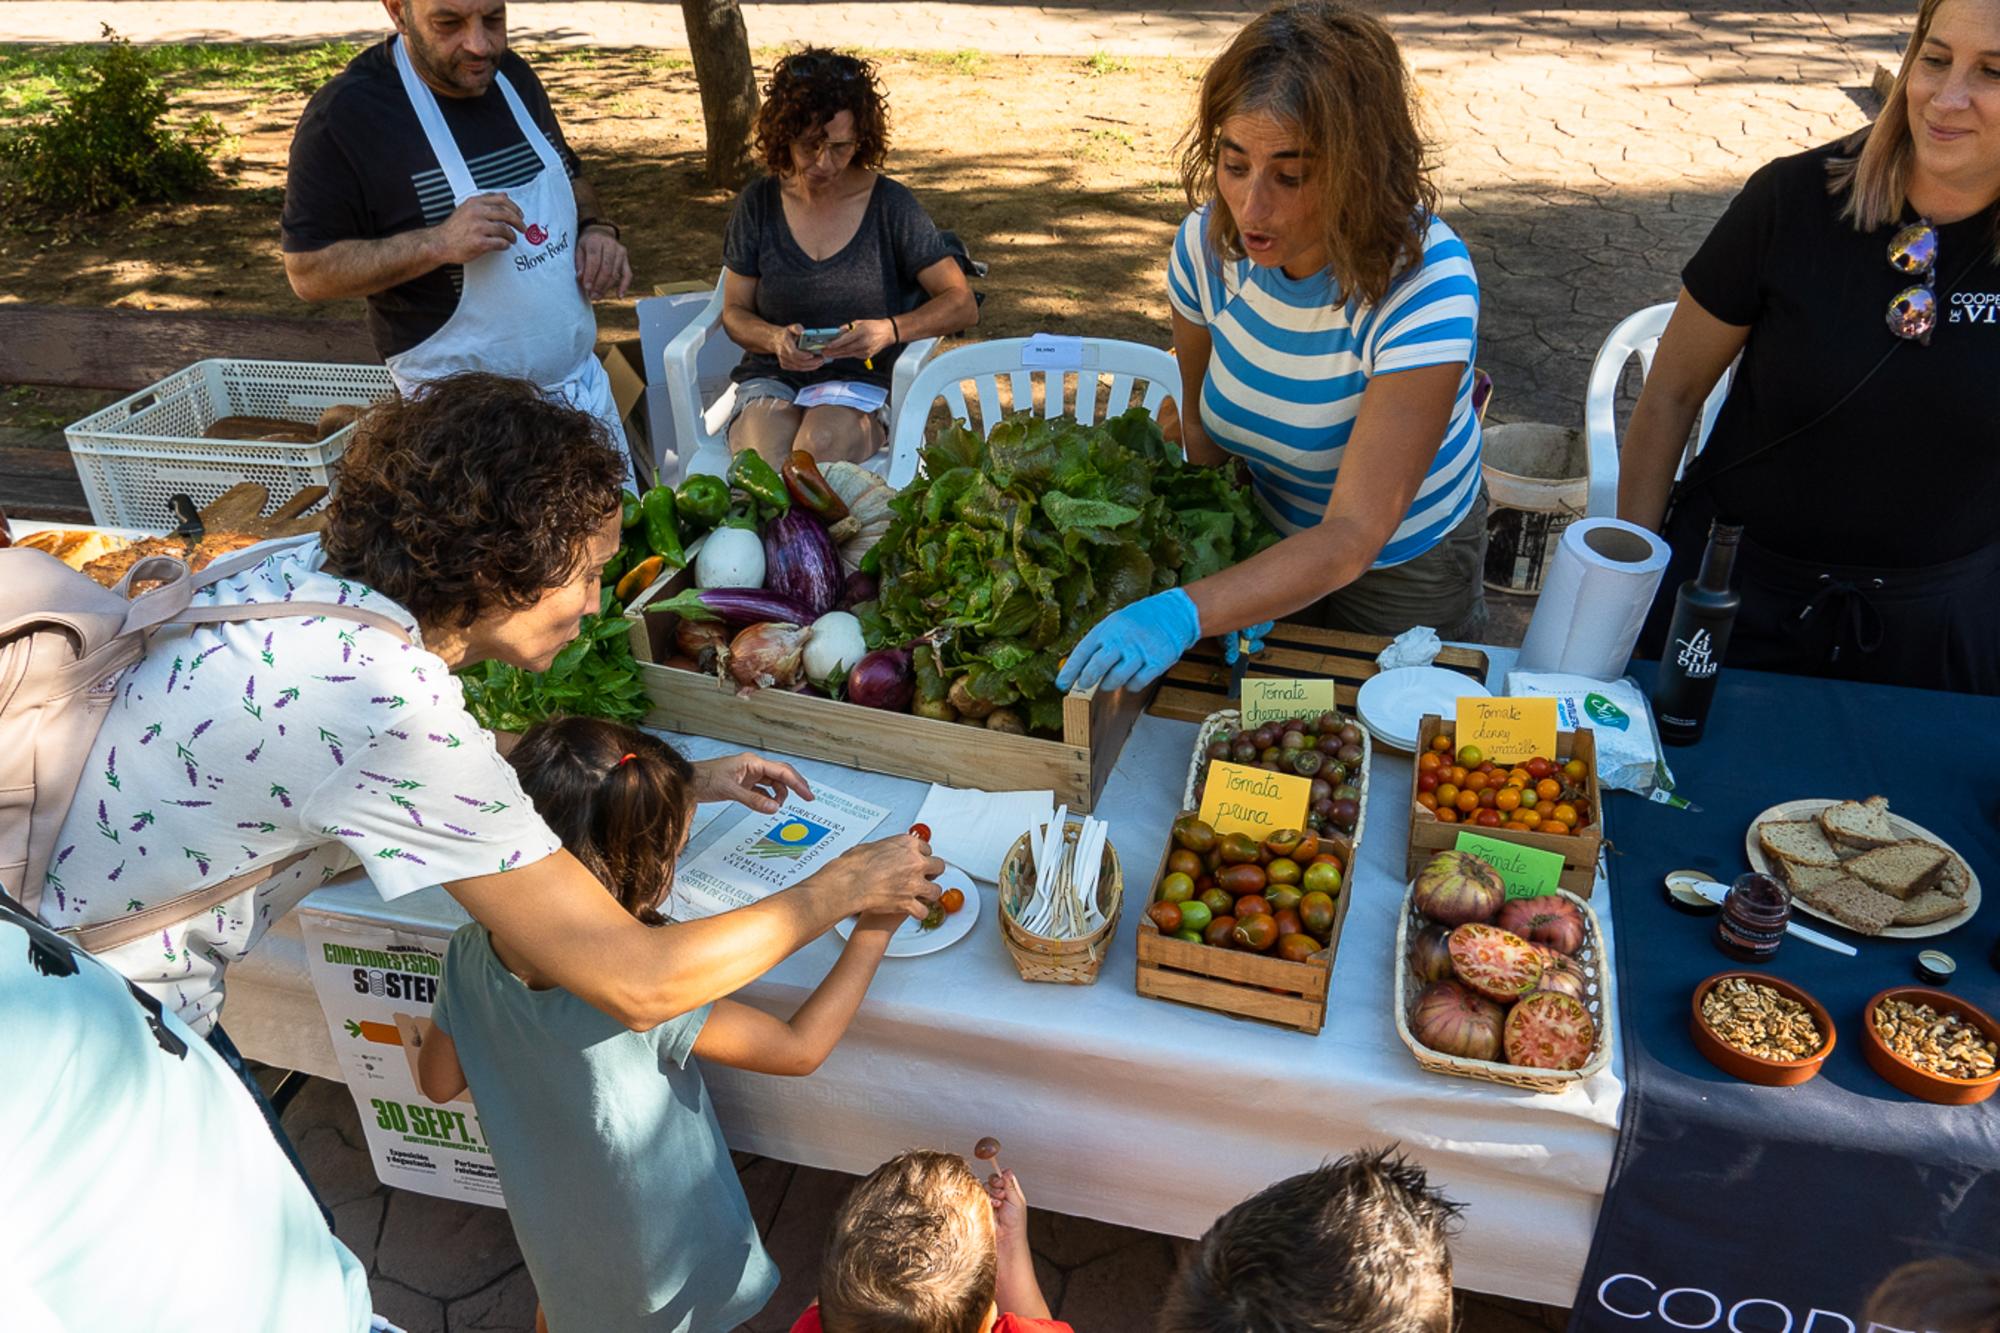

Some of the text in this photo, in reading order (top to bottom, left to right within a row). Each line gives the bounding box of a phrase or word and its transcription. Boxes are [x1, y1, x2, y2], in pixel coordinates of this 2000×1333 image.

[514, 232, 569, 272] Slow Food
[1254, 680, 1308, 700] Tomate
[1246, 699, 1289, 723] cherry
[1476, 703, 1521, 720] Tomate
[1221, 767, 1283, 800] Tomata
[787, 804, 846, 833] AGRICULTURA
[722, 856, 784, 886] VALENCIANA
[729, 852, 787, 881] COMUNITAT
[1470, 844, 1529, 875] Tomate
[688, 868, 736, 894] AGRICULTURA
[323, 943, 402, 972] COMEDORES
[370, 1098, 408, 1134] 30
[407, 1104, 477, 1145] SEPT.
[1597, 1273, 1916, 1333] COOP
